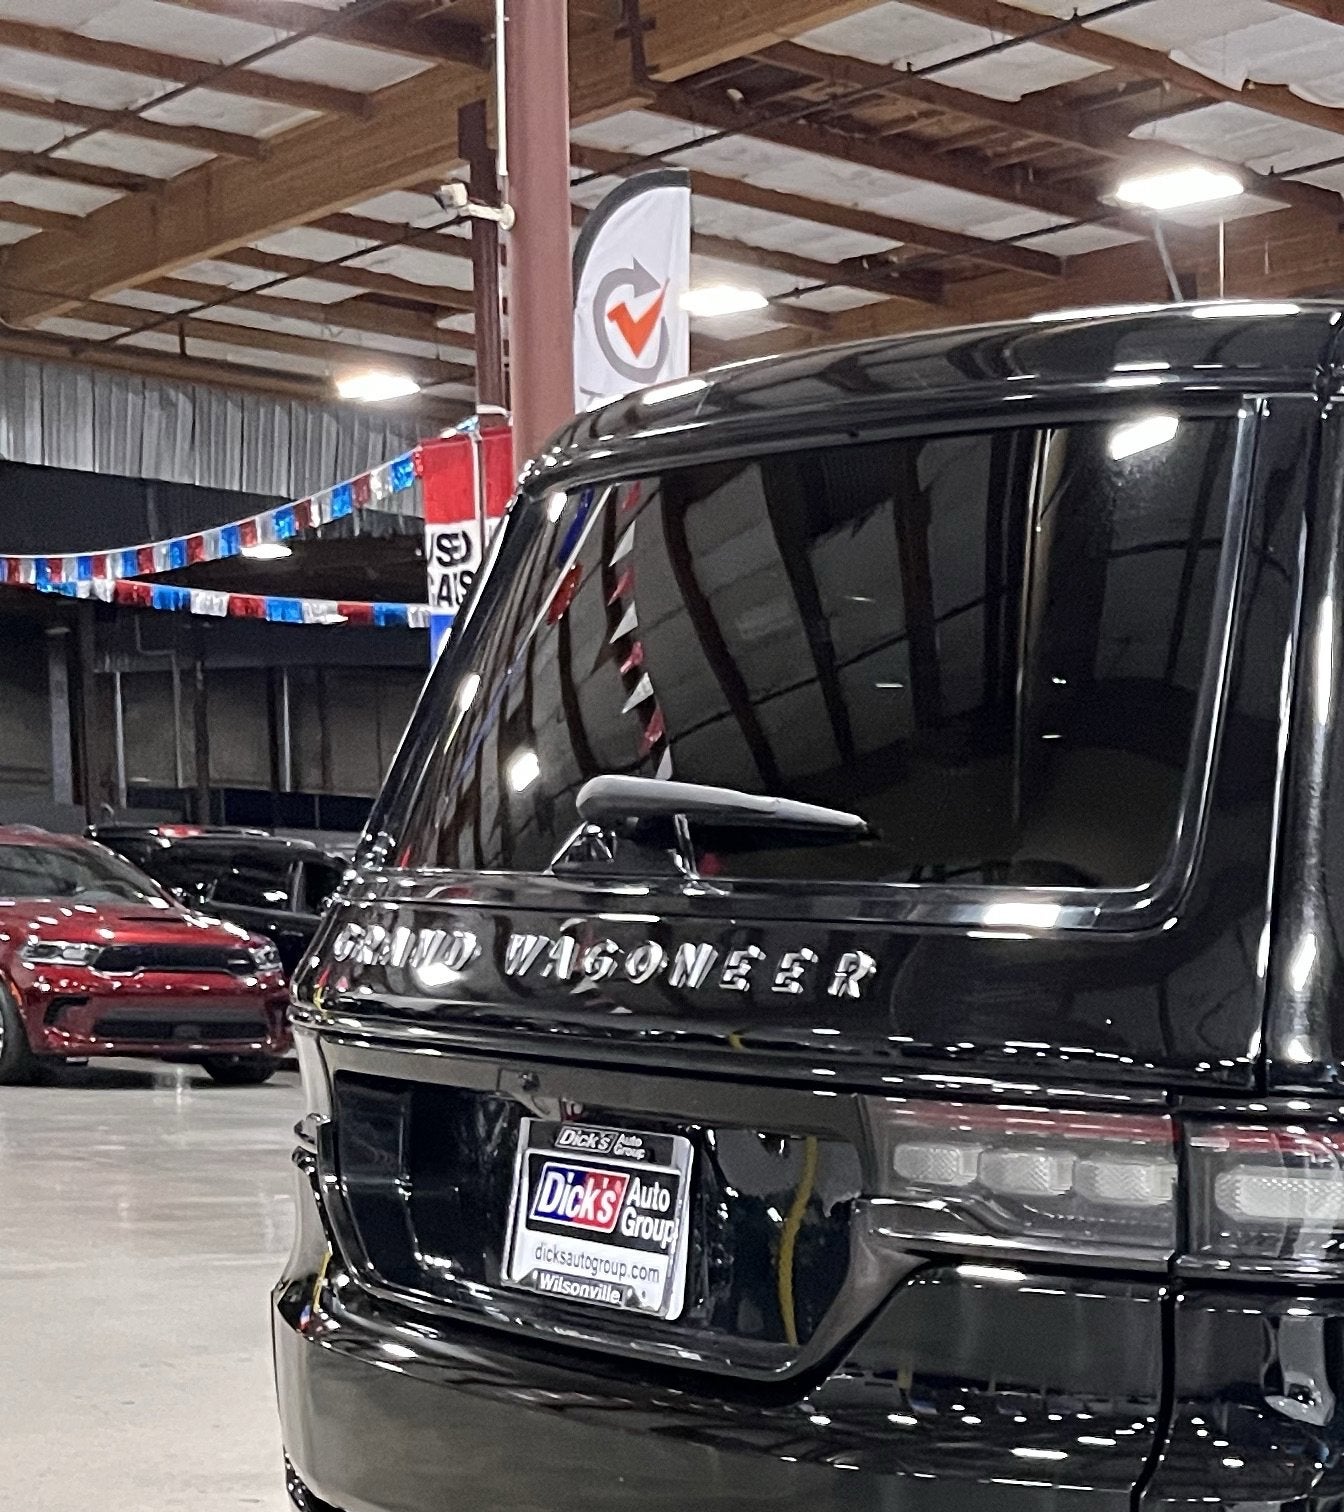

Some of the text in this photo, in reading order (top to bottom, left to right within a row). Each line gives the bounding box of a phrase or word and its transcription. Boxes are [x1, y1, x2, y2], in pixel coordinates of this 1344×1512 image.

[505, 934, 877, 998] WAGONEER
[559, 1129, 612, 1150] Dick's
[538, 1170, 671, 1224] Dick's Auto
[621, 1207, 677, 1249] Group
[535, 1242, 660, 1283] dicksautogroup.com
[540, 1271, 622, 1304] Wilsonville
